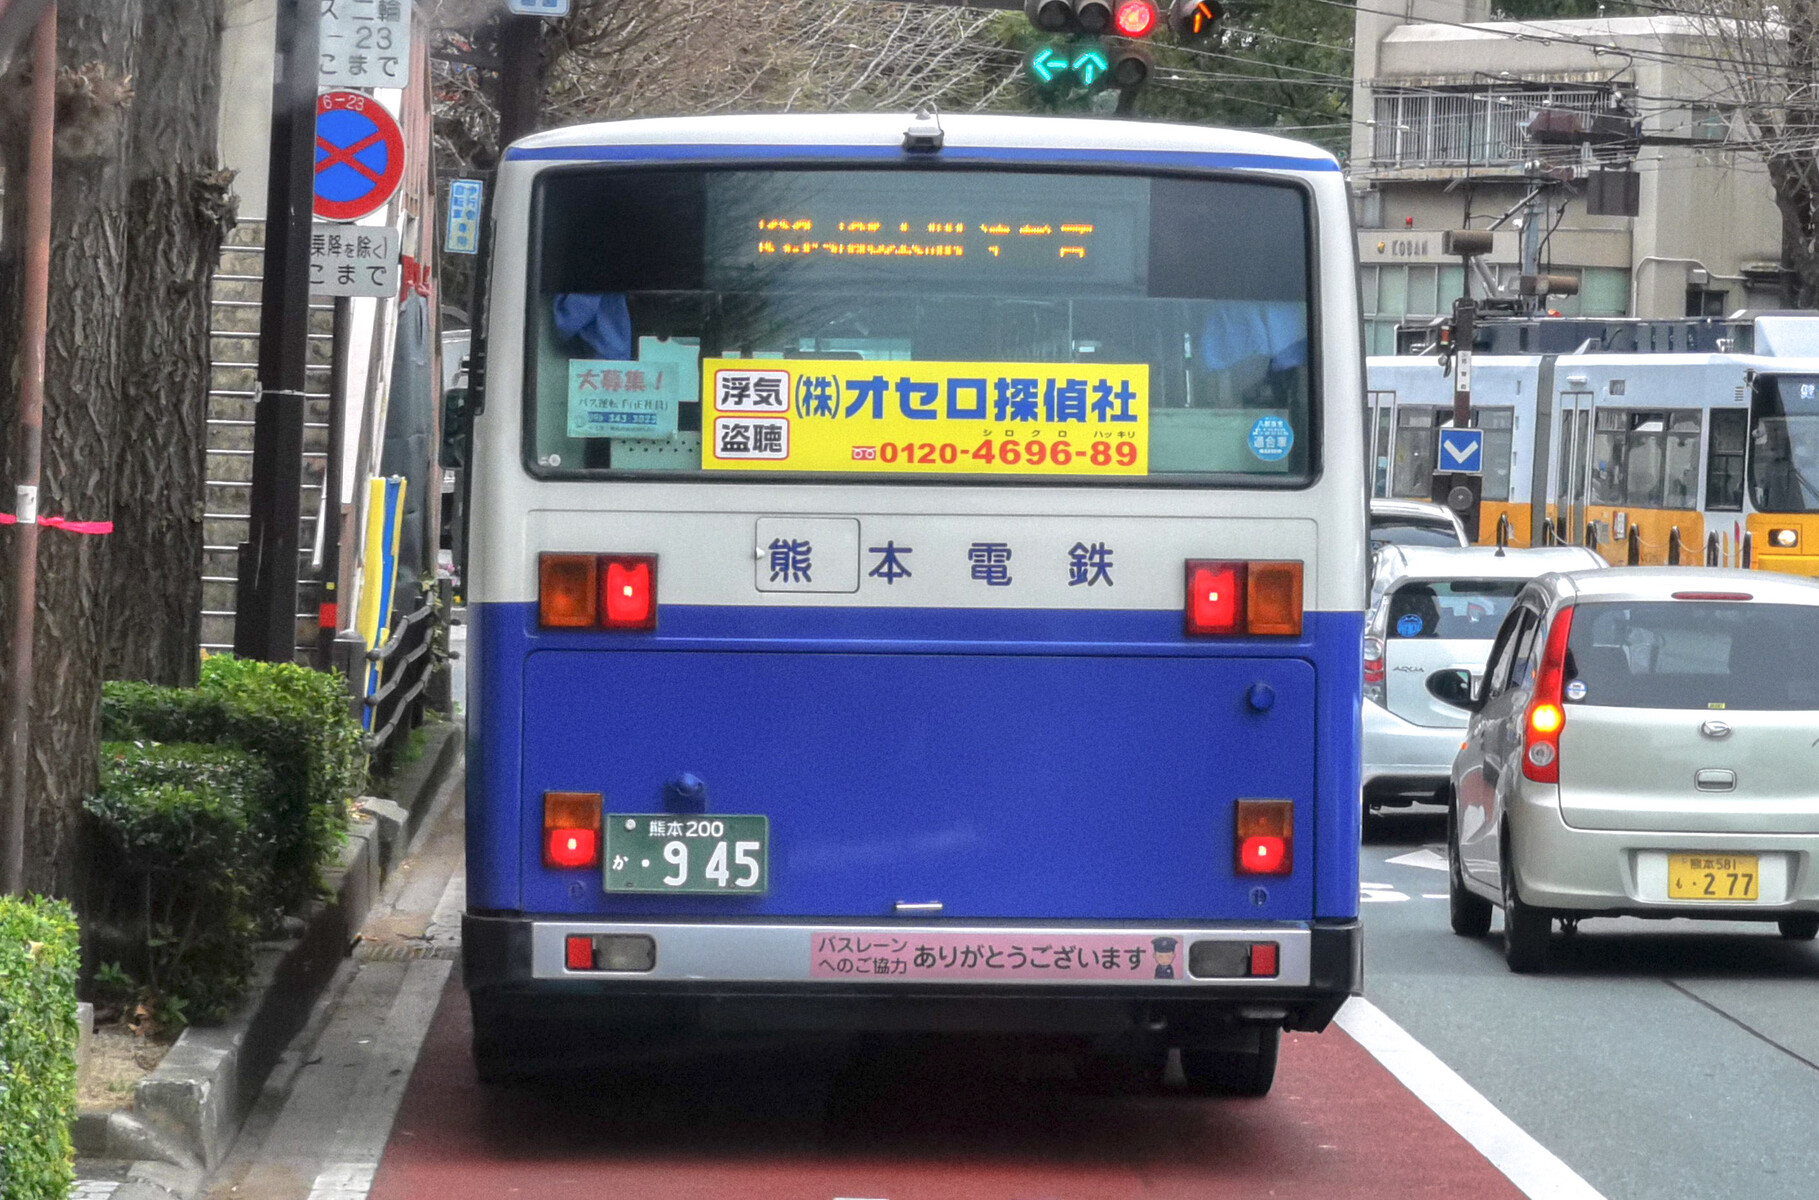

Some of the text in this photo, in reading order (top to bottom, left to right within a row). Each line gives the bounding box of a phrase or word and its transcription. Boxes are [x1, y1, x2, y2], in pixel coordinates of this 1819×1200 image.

[721, 377, 783, 406] 浮気
[720, 423, 783, 453] 盗聴
[880, 439, 1138, 467] 0120-4696-89
[819, 936, 908, 953] バスレーン
[913, 944, 1147, 970] ありがとうございます
[819, 957, 907, 975] へのご協力
